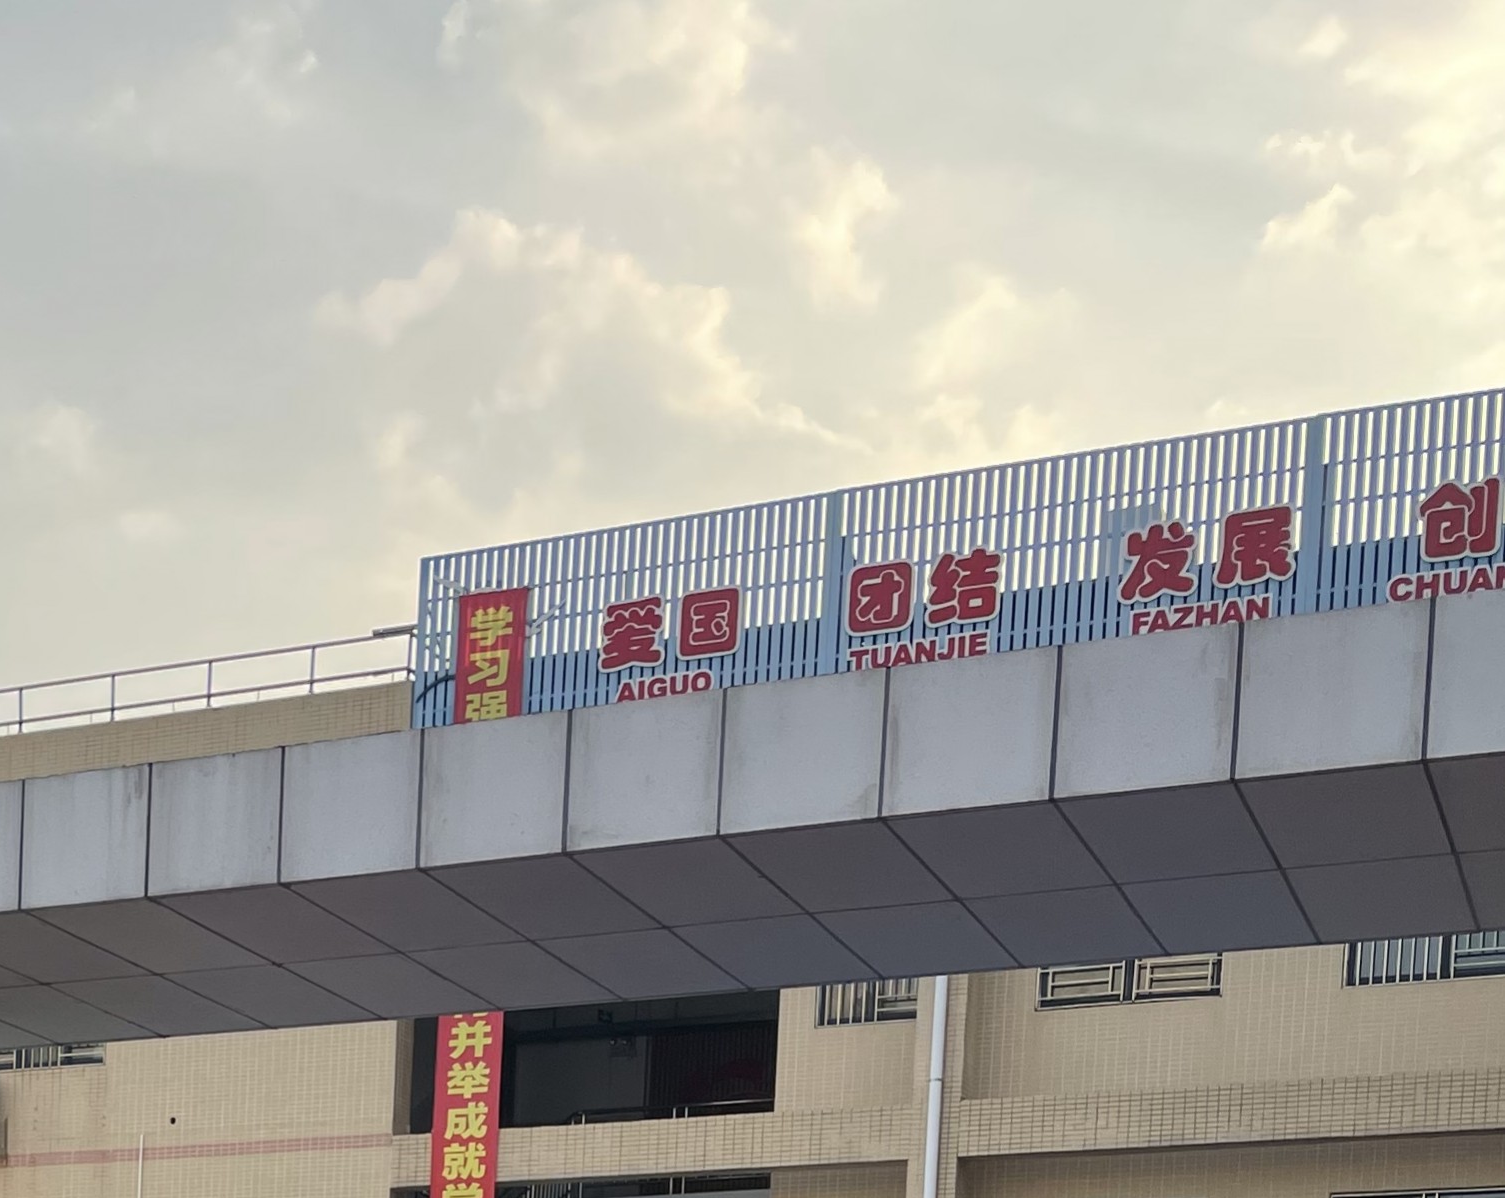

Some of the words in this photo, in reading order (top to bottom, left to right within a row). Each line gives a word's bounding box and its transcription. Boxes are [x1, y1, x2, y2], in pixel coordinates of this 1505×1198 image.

[599, 586, 742, 673] 爱国
[846, 547, 1000, 636] 团结
[1119, 505, 1296, 603] 发展
[1418, 475, 1501, 561] 创
[616, 671, 712, 703] AIGUO
[849, 631, 988, 671] TUANJIE
[1131, 595, 1271, 637] FAZHAN
